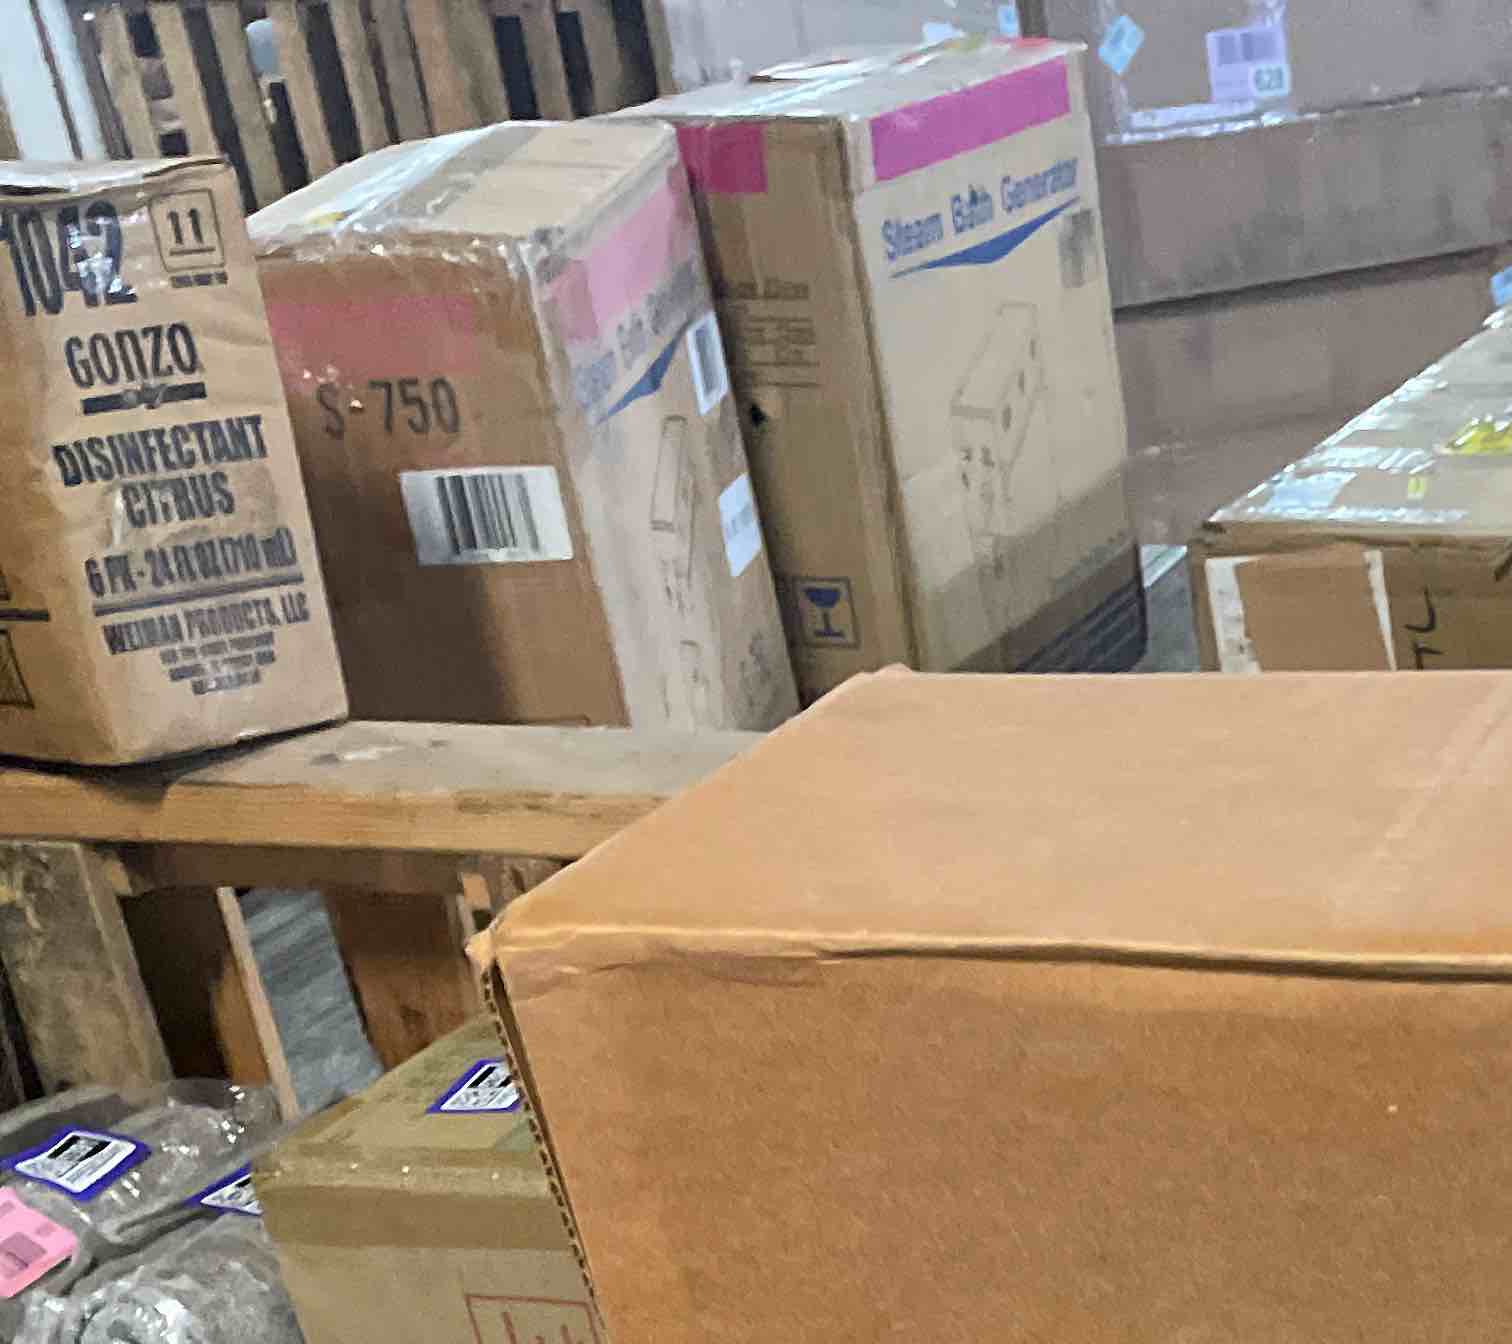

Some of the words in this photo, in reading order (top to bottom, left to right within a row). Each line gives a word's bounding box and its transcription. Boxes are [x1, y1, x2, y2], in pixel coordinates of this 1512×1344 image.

[65, 322, 200, 389] GONZO
[52, 415, 267, 487] DISINFECTANT
[122, 471, 235, 529] CITRUS
